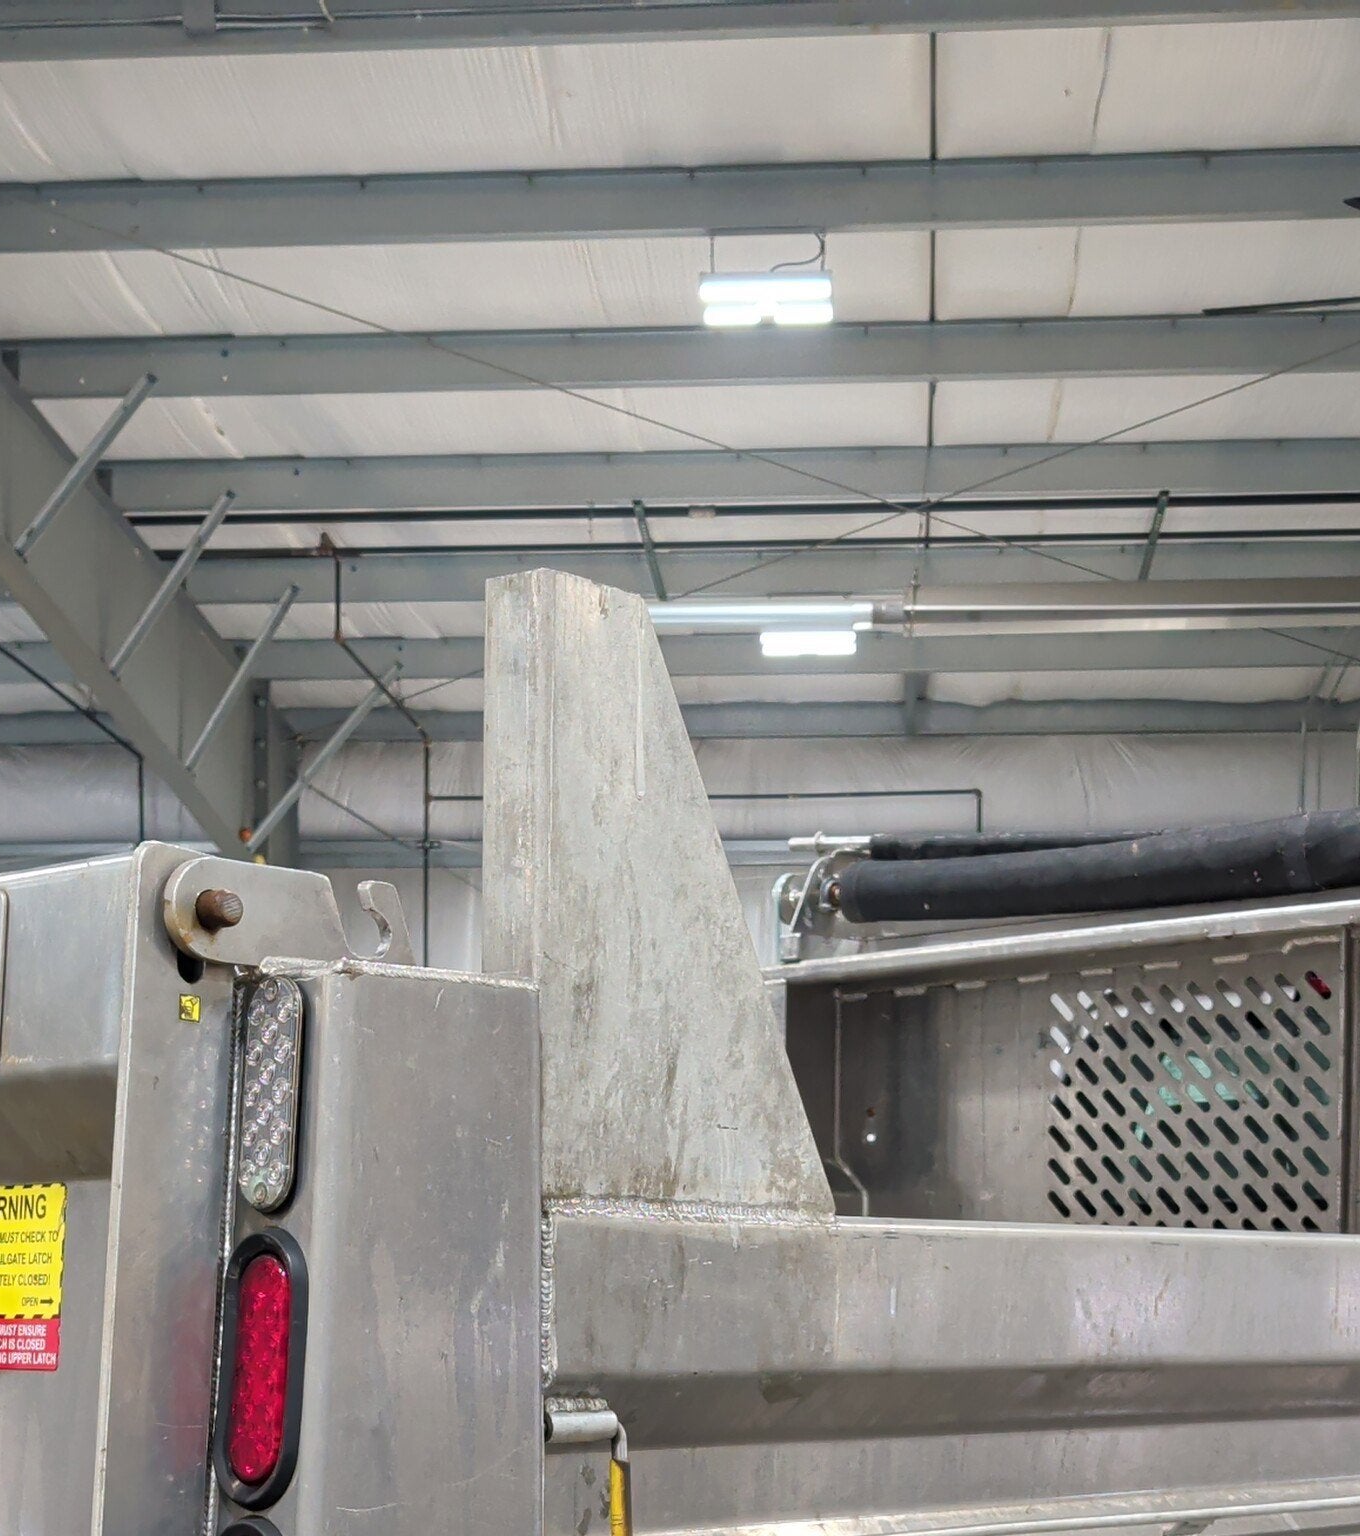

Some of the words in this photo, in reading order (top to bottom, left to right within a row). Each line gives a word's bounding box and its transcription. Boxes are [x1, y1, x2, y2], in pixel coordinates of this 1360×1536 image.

[20, 1231, 46, 1244] CHECK
[48, 1230, 59, 1242] TO
[28, 1252, 52, 1264] LATCH
[17, 1273, 51, 1286] CLOSED!
[21, 1296, 38, 1306] OPEN
[18, 1324, 47, 1336] ENSURE
[8, 1338, 15, 1350] IS
[16, 1338, 46, 1351] CLOSED
[7, 1352, 32, 1364] UPPER
[33, 1352, 56, 1365] LATCH
